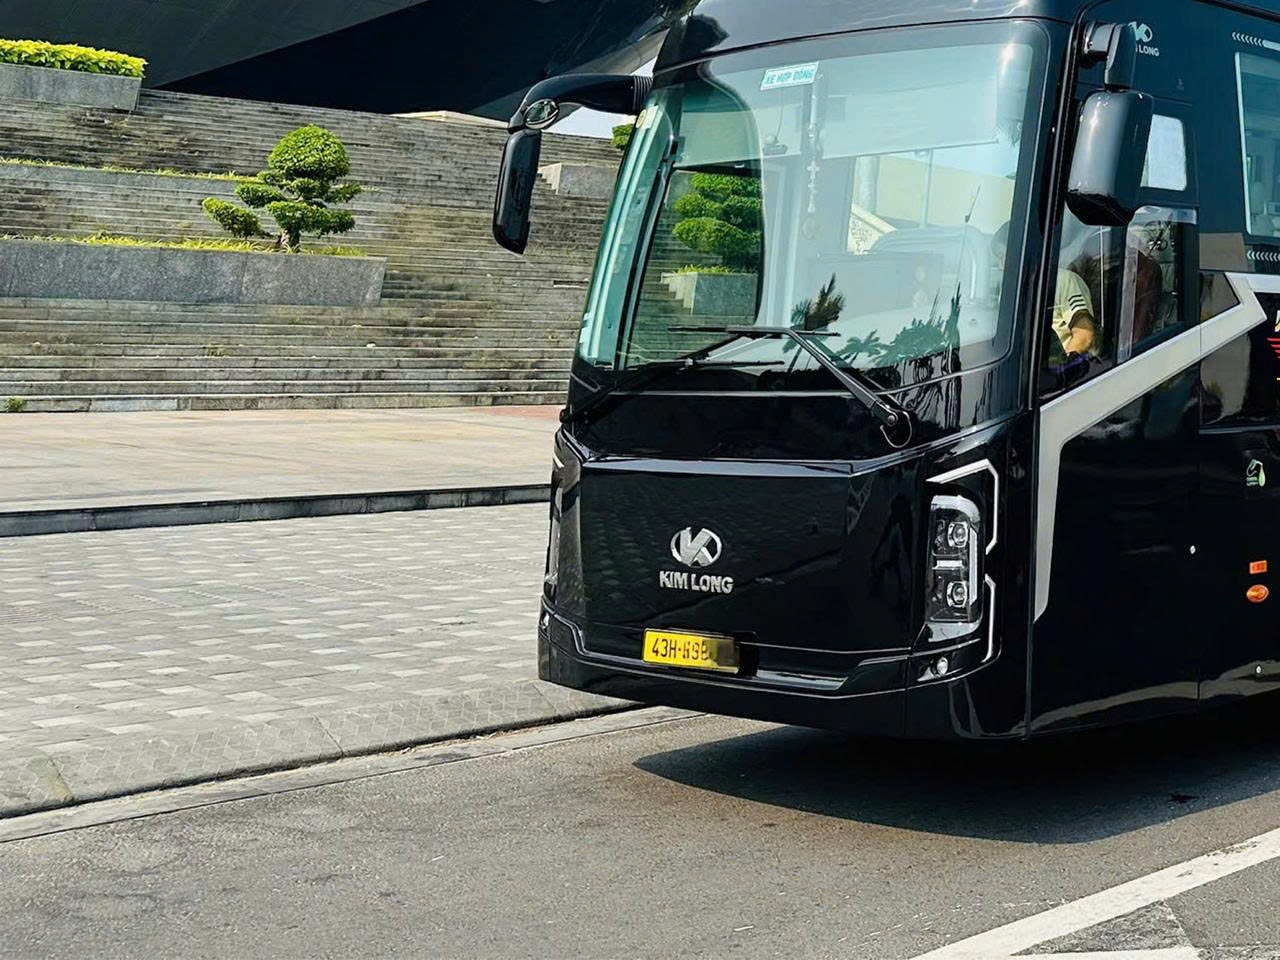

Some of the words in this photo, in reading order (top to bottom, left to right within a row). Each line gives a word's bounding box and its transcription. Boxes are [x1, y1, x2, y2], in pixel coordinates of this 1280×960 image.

[1139, 44, 1160, 56] LONG
[659, 571, 689, 589] KIM
[691, 574, 735, 593] LONG
